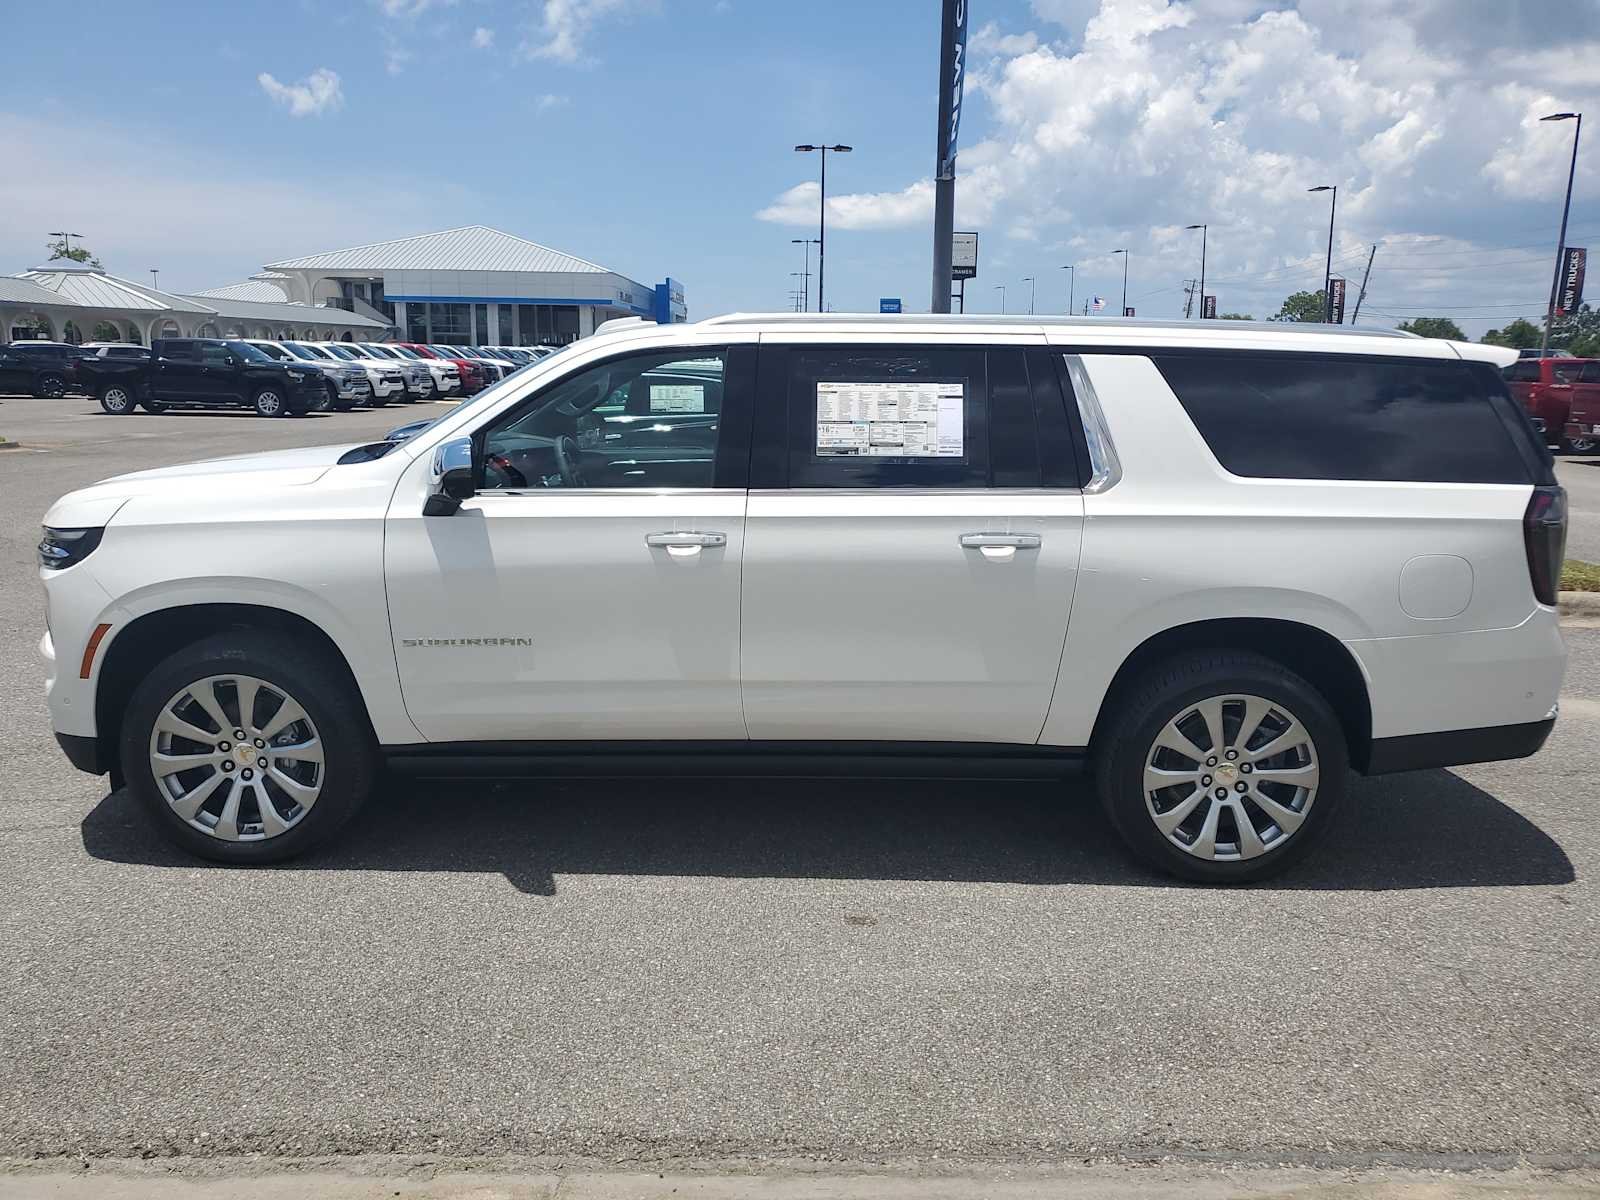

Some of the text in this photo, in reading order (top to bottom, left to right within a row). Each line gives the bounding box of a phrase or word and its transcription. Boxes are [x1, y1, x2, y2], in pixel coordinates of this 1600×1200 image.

[951, 43, 962, 142] NEW
[1333, 281, 1341, 307] TRUCKS
[1563, 251, 1580, 311] NEW TRUCKS
[402, 637, 532, 648] SUBURBAN
